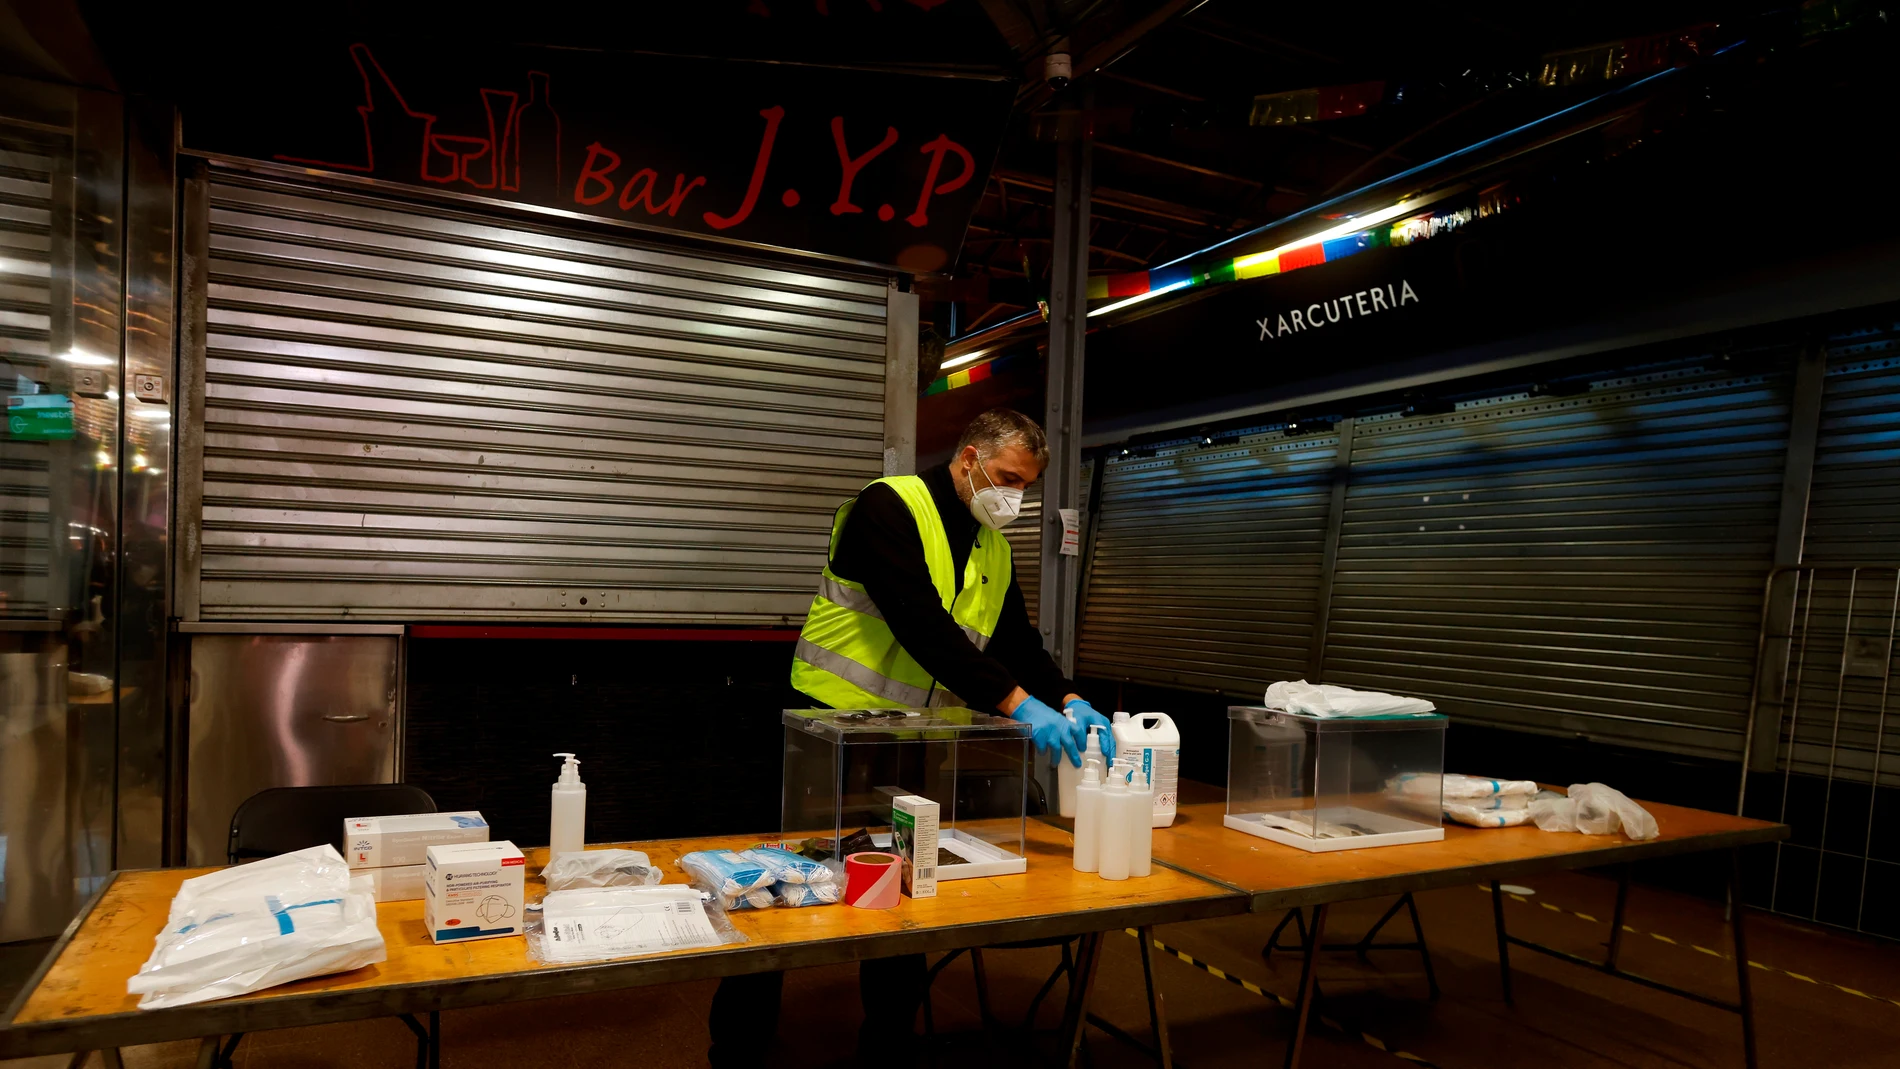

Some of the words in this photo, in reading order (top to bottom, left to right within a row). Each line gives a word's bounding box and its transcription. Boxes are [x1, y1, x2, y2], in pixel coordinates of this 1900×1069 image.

[574, 142, 706, 217] Bar
[703, 105, 976, 229] J.Y.P
[1256, 279, 1419, 341] XARCUTERIA
[359, 853, 366, 861] L
